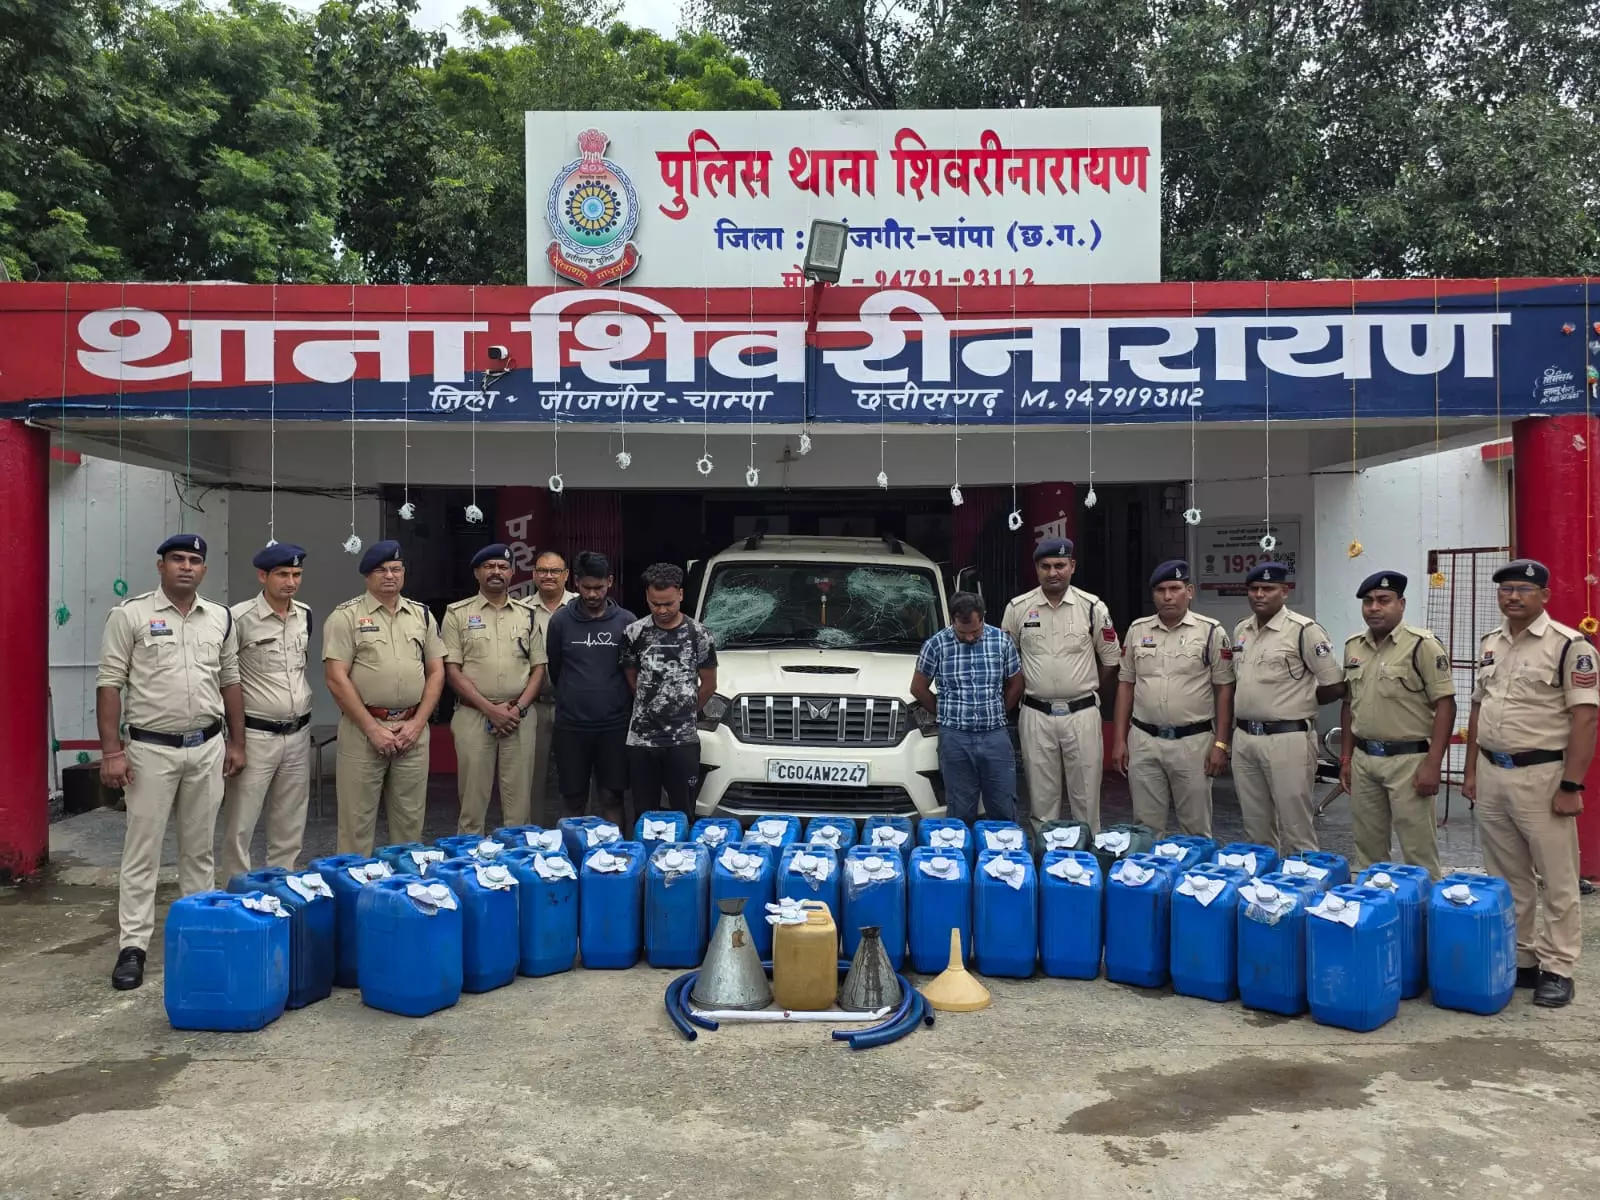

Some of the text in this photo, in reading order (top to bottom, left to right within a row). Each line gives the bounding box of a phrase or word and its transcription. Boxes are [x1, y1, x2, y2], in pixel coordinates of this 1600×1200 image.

[655, 127, 1150, 220] पुलिस थाना शिवरीनारायण
[714, 217, 785, 250] जिला
[1006, 218, 1102, 252] (छ.ग.)
[875, 267, 1035, 288] 94791-93112
[77, 289, 1511, 383] थाना शिवरीनारायण
[428, 384, 500, 412] जिला
[1064, 386, 1204, 410] 9479193112
[778, 765, 866, 783] CG04AW2247
